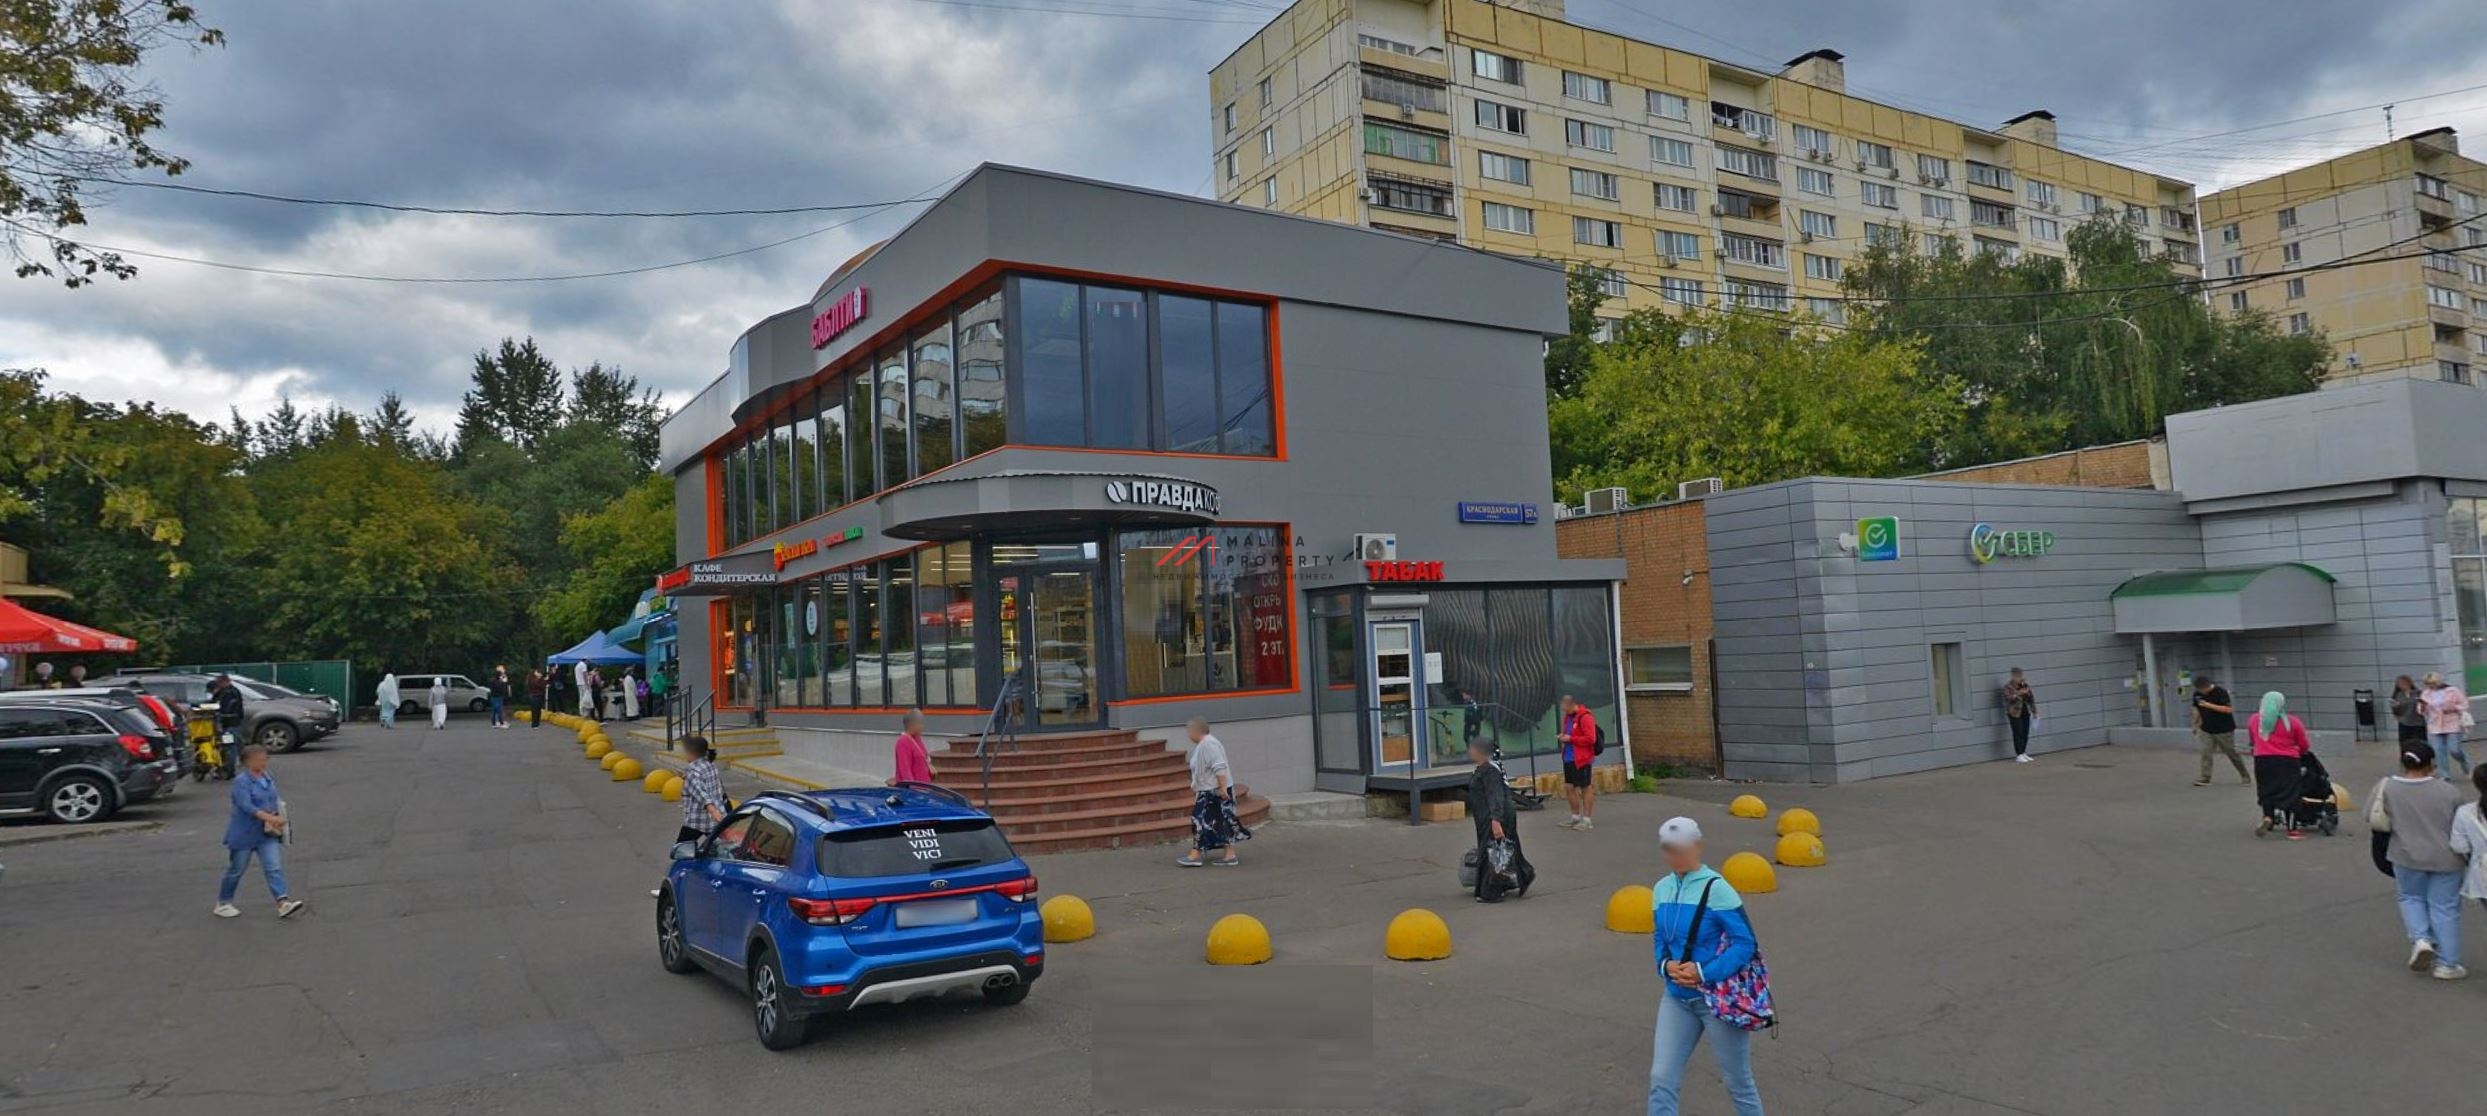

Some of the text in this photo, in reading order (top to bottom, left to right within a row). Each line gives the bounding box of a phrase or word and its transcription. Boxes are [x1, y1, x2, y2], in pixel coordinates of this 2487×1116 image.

[1466, 505, 1518, 514] КРАСНОДАРСКАЯ
[2000, 530, 2055, 556] СБЕР
[693, 564, 722, 573] КАФЕ
[1365, 560, 1445, 582] ТАБАК
[693, 574, 776, 584] КОНДИТЕРСКАЯ
[1261, 641, 1269, 656] 2
[903, 828, 937, 838] VENI
[909, 838, 940, 849] VIDI
[912, 849, 942, 860] VICI
